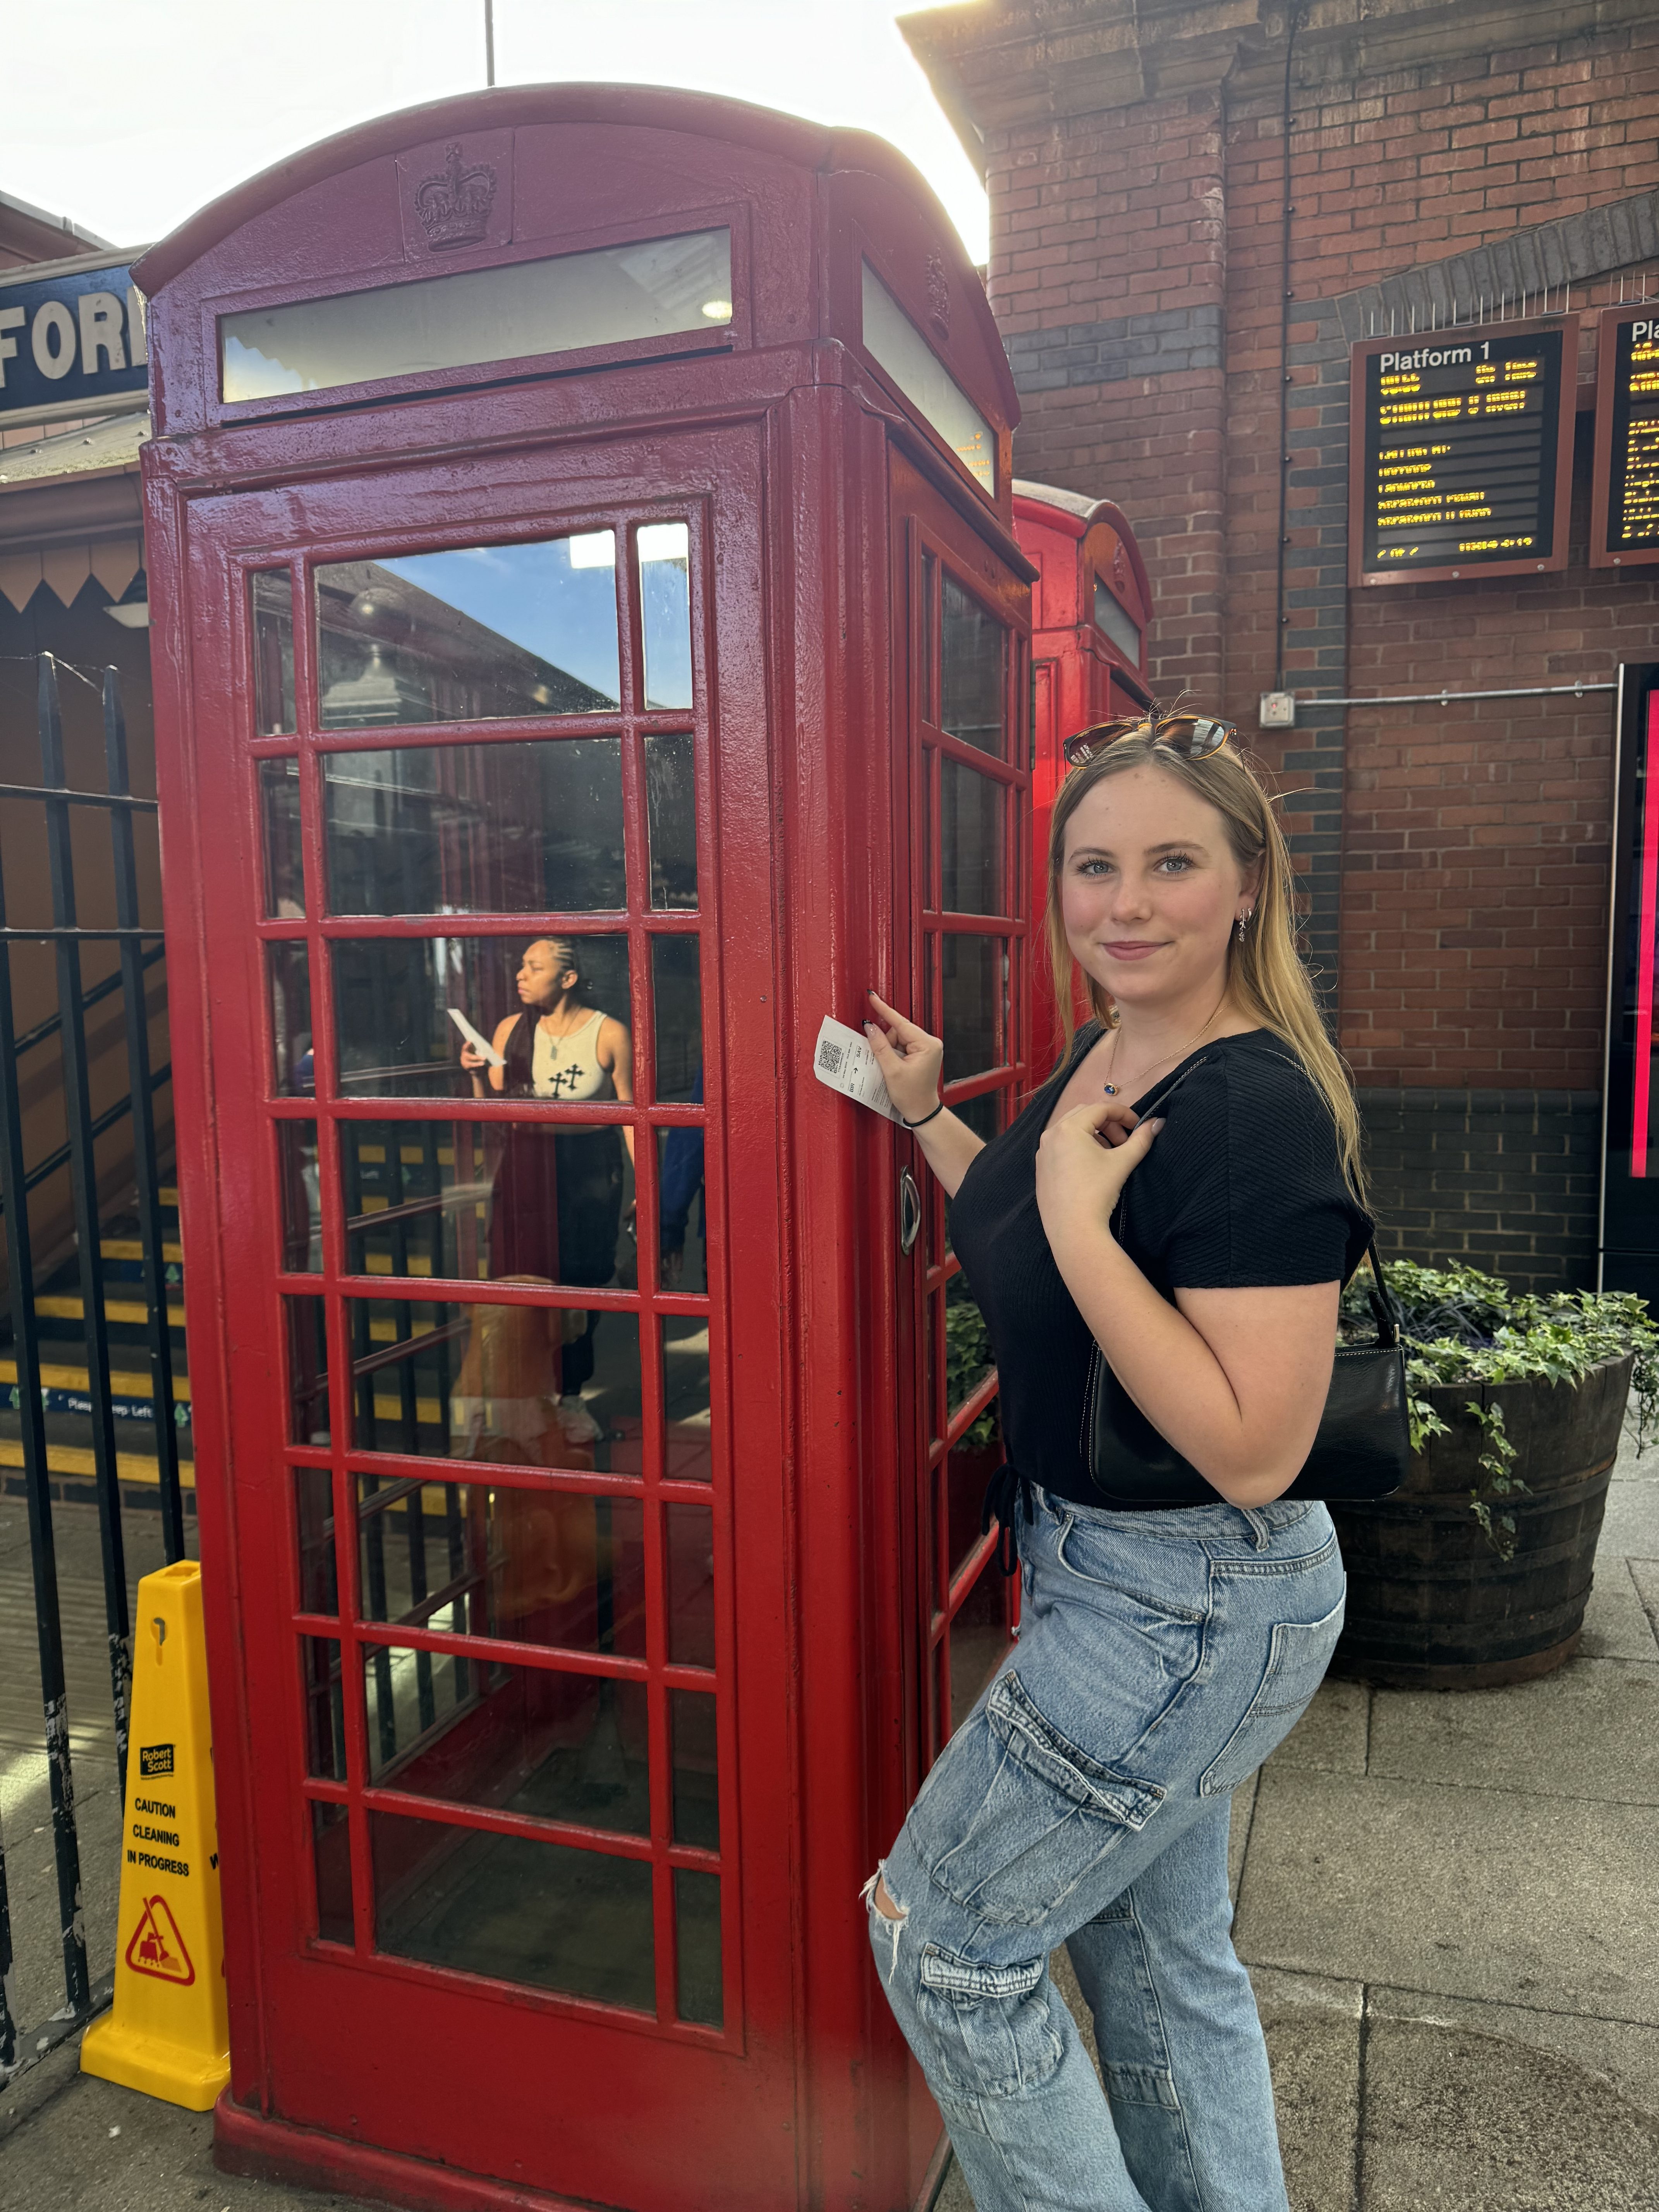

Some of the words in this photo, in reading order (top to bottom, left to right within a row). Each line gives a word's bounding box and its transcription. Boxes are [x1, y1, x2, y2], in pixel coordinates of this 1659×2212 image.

[1380, 348, 1471, 373] Platform
[1481, 342, 1489, 360] 1
[132, 1405, 152, 1418] Left
[143, 1748, 171, 1762] Robert
[148, 1759, 171, 1772] Scott
[135, 1798, 175, 1819] CAUTION
[133, 1824, 179, 1847] CLEANING
[127, 1850, 136, 1863] IN
[139, 1853, 189, 1877] PROGRESS
